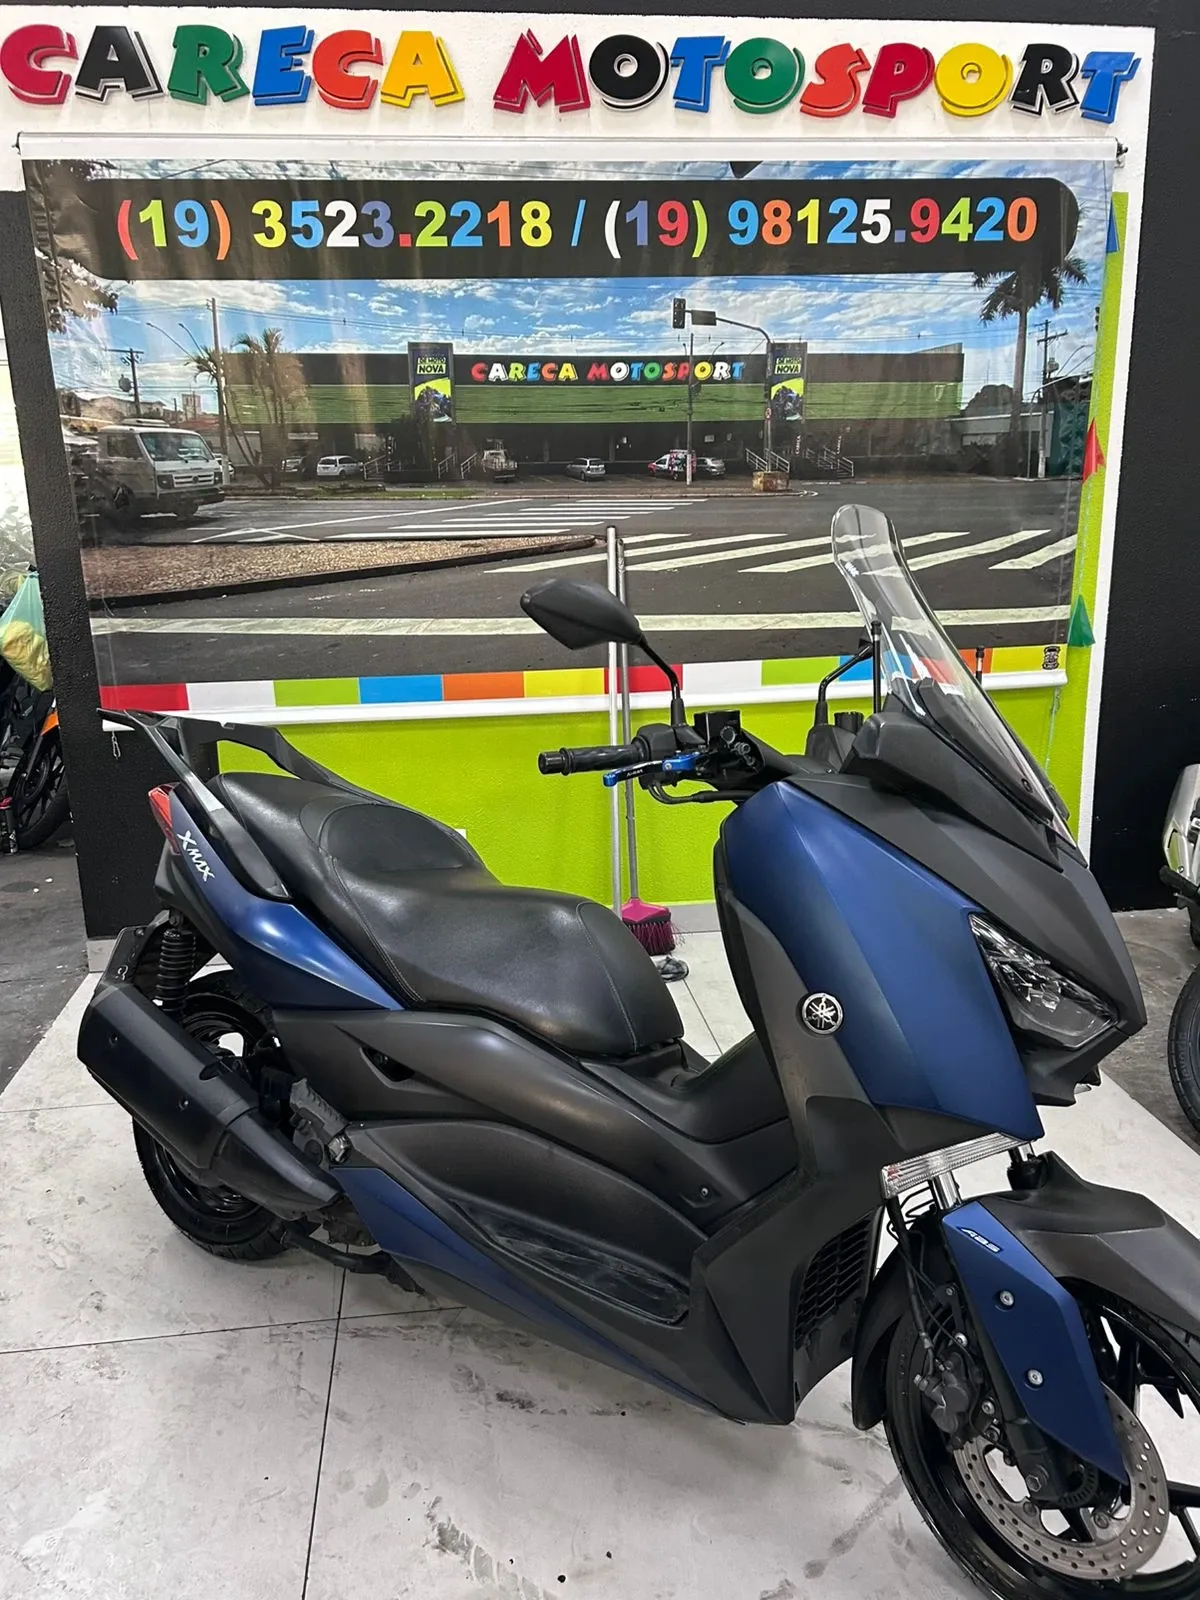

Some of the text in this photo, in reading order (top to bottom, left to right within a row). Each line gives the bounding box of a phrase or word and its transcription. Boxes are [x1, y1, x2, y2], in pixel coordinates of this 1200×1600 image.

[0, 23, 1141, 124] CARECA MOTOSPORT
[117, 199, 231, 260] (19)
[252, 199, 553, 248] 3523.2218
[604, 199, 708, 258] (19)
[727, 196, 1038, 245] 98125.9420
[418, 365, 444, 373] NOVA
[471, 361, 746, 382] CARECA MOTOSPORT
[776, 365, 799, 373] NOVA
